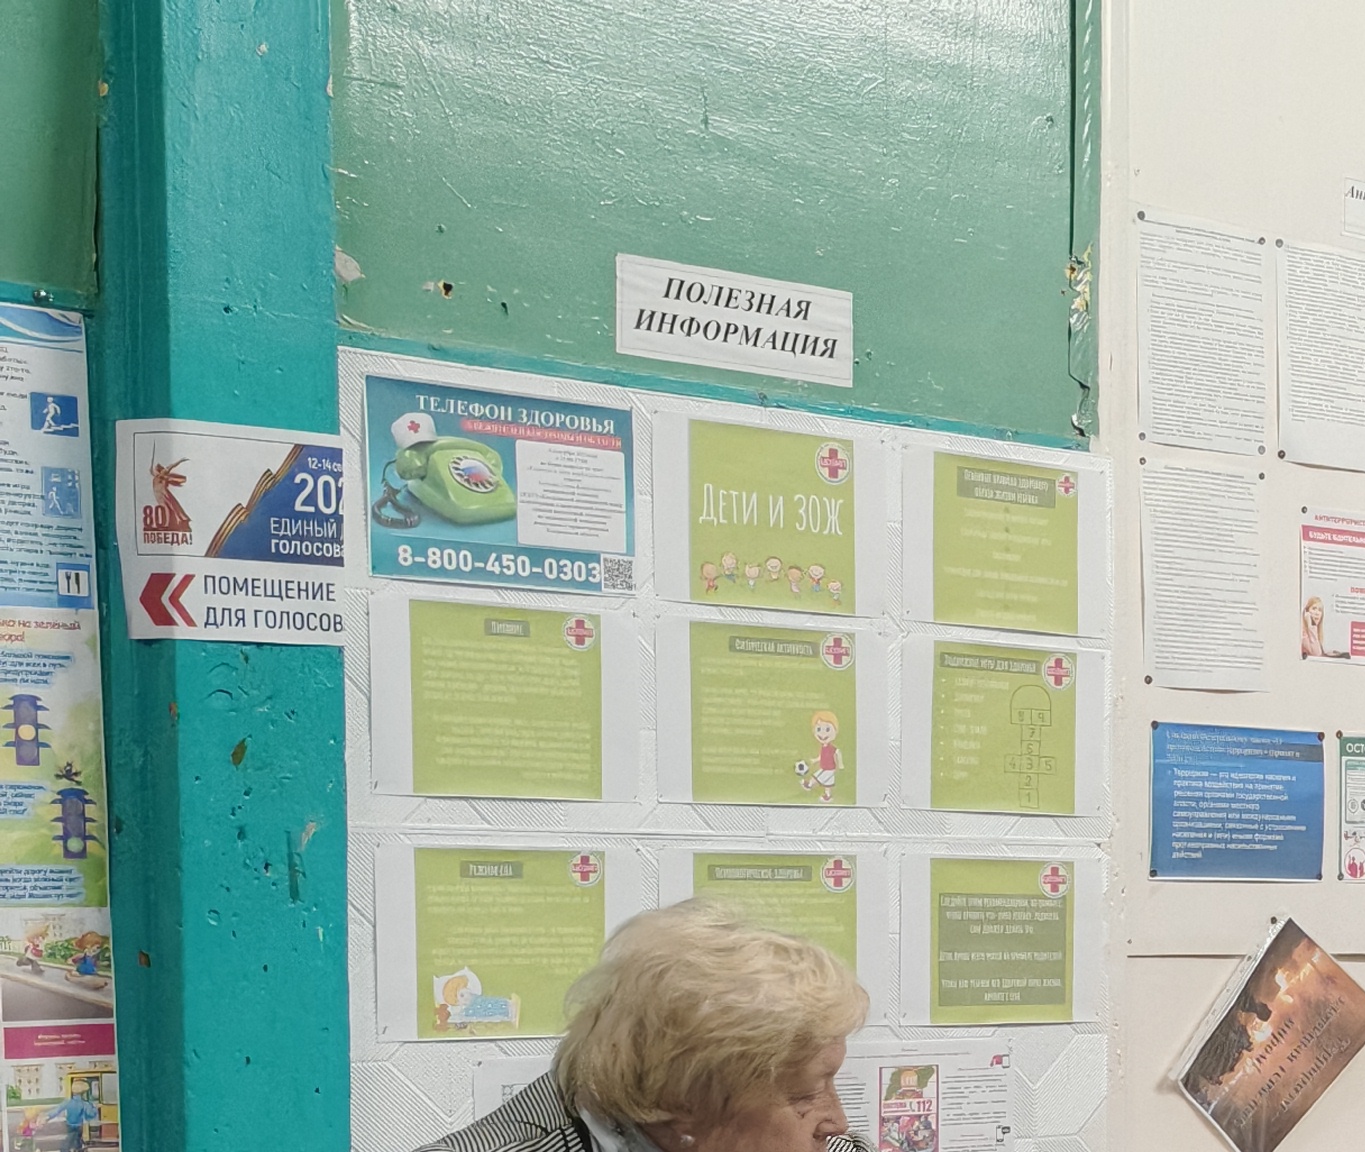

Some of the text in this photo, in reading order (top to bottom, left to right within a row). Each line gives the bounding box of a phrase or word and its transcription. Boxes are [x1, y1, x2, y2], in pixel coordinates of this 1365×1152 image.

[662, 277, 812, 321] ПОЛЕЗНАЯ
[633, 308, 838, 359] ИНФОРМАЦИЯ
[415, 394, 615, 436] ТЕЛЕФОН ЗДОРОВЬЯ
[307, 457, 331, 471] 12-14
[270, 517, 337, 539] ЕДИНЫЙ
[794, 494, 844, 536] ЗОЖ
[143, 531, 193, 546] ПОБЕДА!
[398, 544, 600, 583] 8-800-450-0303
[203, 575, 336, 602] ПОМЕЩЕНИЕ
[204, 607, 246, 629] ДЛЯ
[916, 1100, 933, 1113] 112
